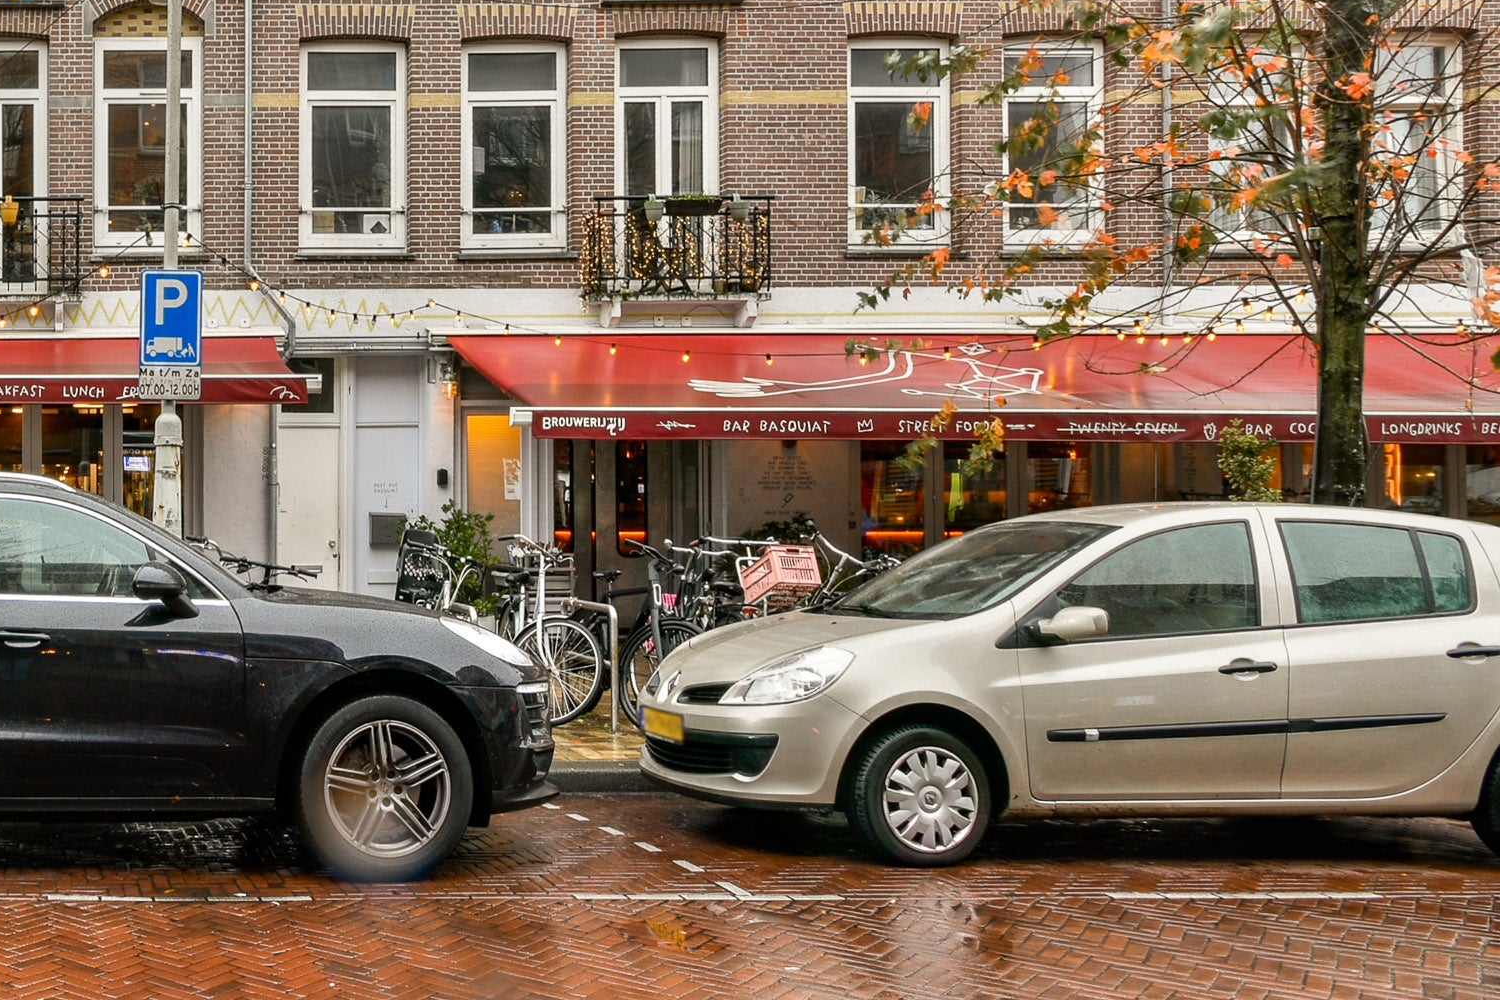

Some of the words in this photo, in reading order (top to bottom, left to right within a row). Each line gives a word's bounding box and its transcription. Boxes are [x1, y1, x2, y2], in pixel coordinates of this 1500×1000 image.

[155, 279, 188, 325] P
[140, 368, 155, 378] Ma
[159, 368, 181, 378] t/m
[186, 368, 199, 378] Za
[63, 385, 104, 398] LUNCH
[140, 384, 199, 395] 07.00-12.00H
[723, 420, 749, 433] BAR
[760, 420, 831, 433] BASQUIAT
[1245, 423, 1272, 436] BAR
[1289, 422, 1317, 434] COC
[1381, 422, 1462, 436] LONGDRINKS
[1481, 422, 1500, 434] BE
